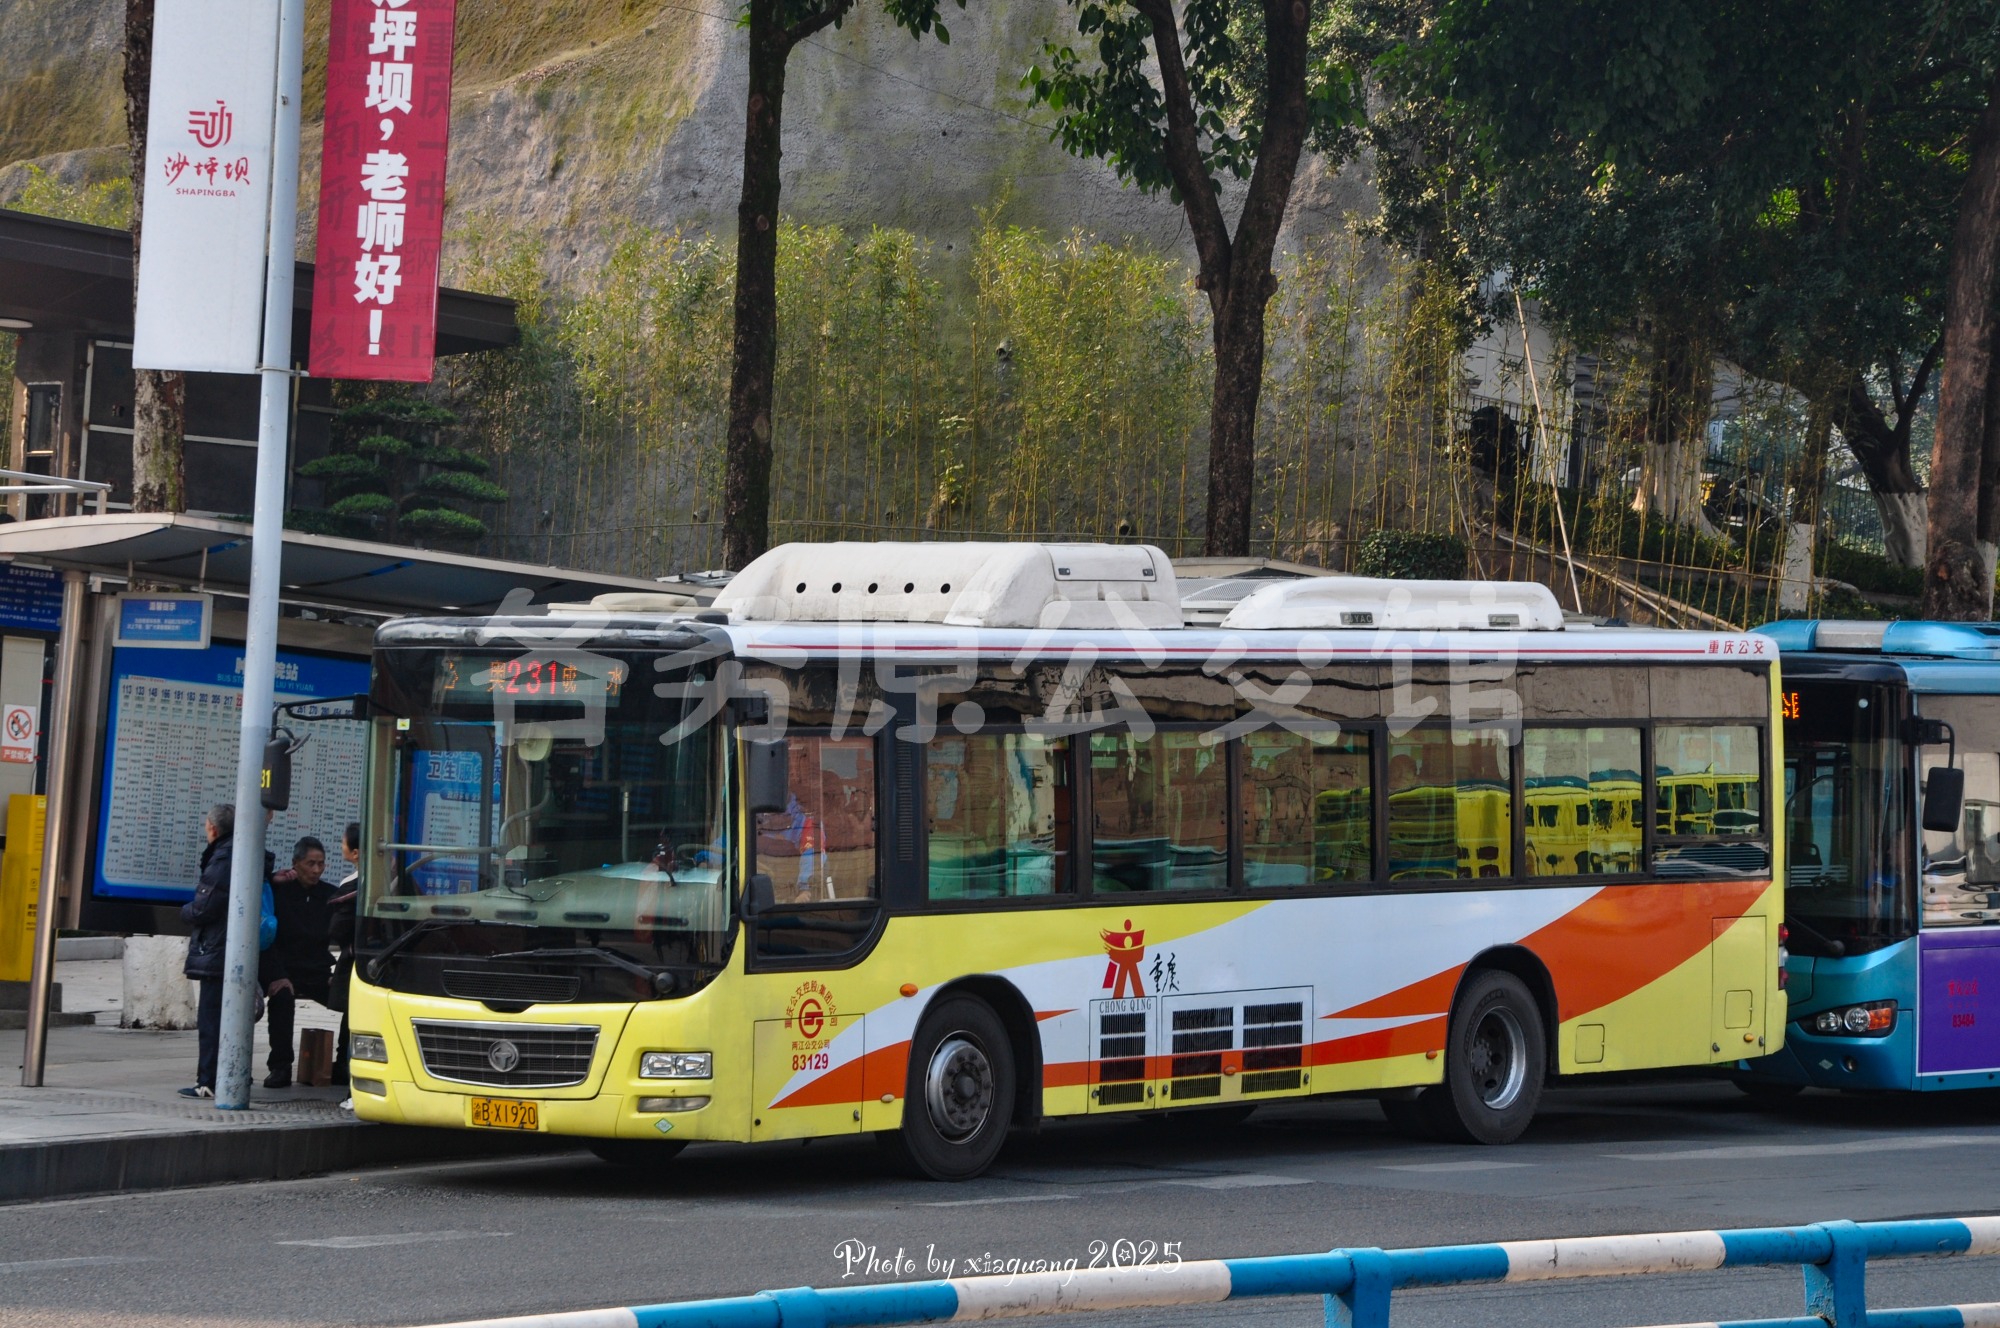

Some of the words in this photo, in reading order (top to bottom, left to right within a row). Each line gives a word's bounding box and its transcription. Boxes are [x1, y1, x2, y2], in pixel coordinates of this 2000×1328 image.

[164, 151, 251, 187] 沙坪坝
[352, 0, 418, 356] 坪坝，老师好！
[175, 187, 236, 198] SHAPINGBA
[1708, 639, 1764, 655] 重庆公交
[506, 660, 558, 695] 231
[1099, 999, 1127, 1014] CHONG
[1129, 998, 1152, 1012] QING
[791, 1039, 831, 1051] 两江公交公司
[791, 1053, 829, 1071] 83129
